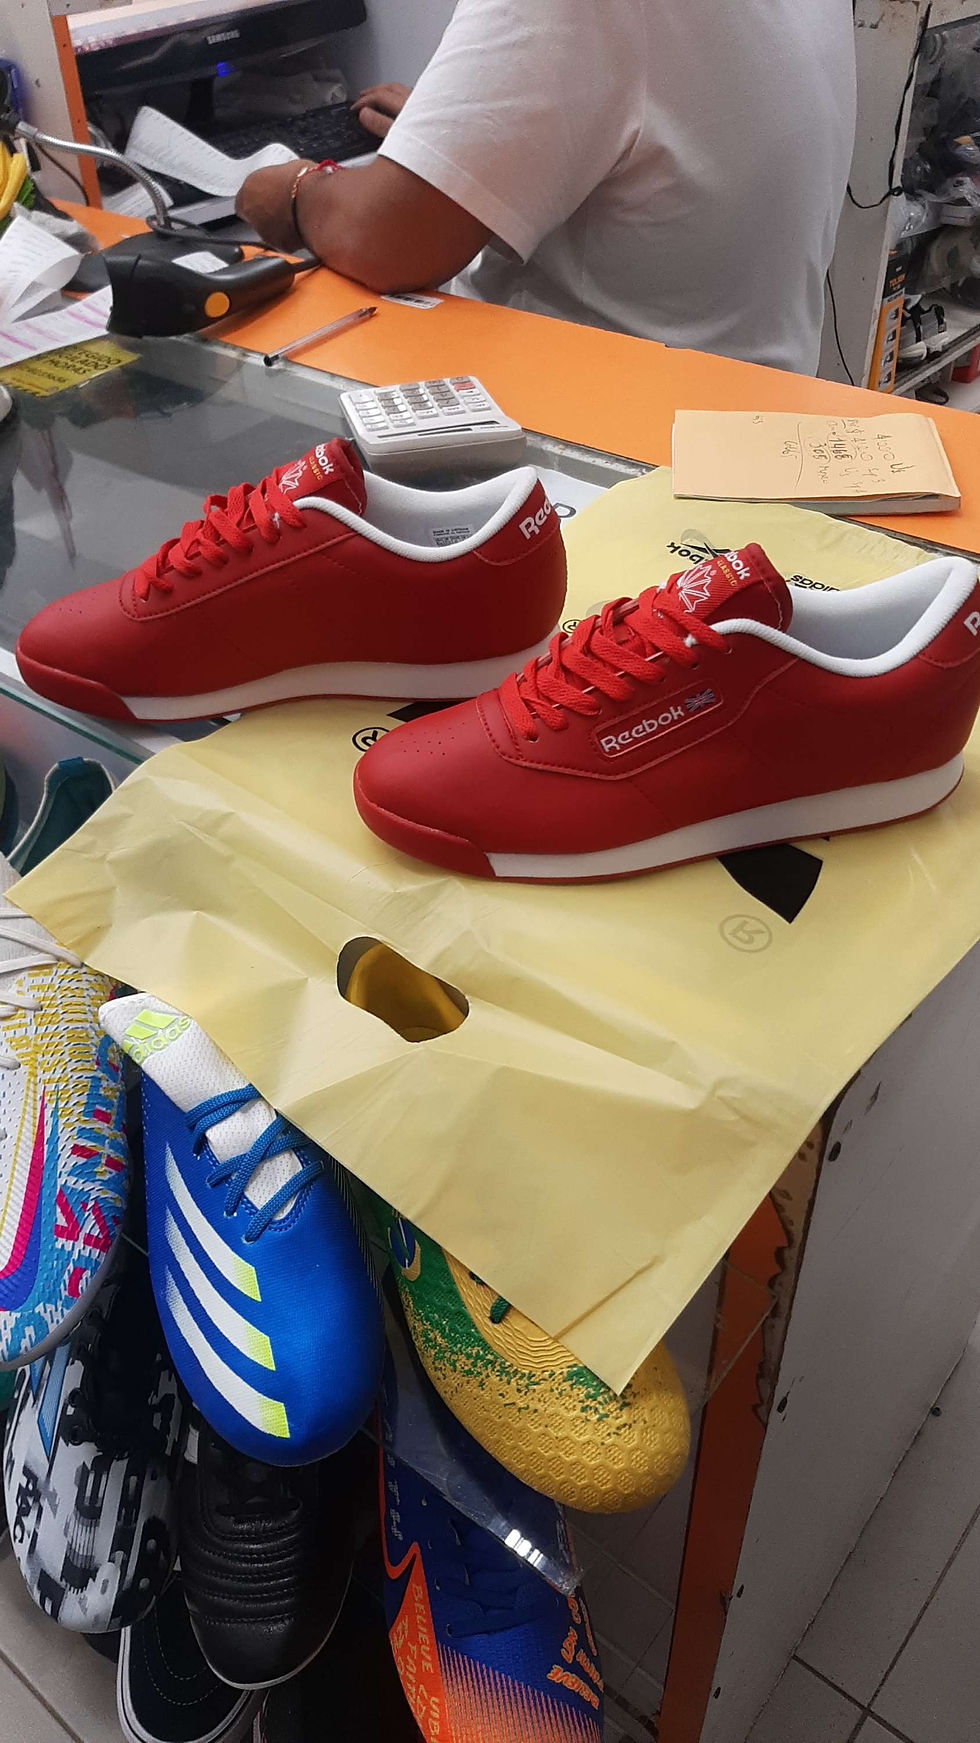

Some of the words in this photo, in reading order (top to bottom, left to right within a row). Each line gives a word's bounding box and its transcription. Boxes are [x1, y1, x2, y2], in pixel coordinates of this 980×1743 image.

[518, 499, 552, 540] Ree
[666, 541, 705, 564] bok
[724, 551, 751, 580] bok
[600, 706, 685, 753] Reebok
